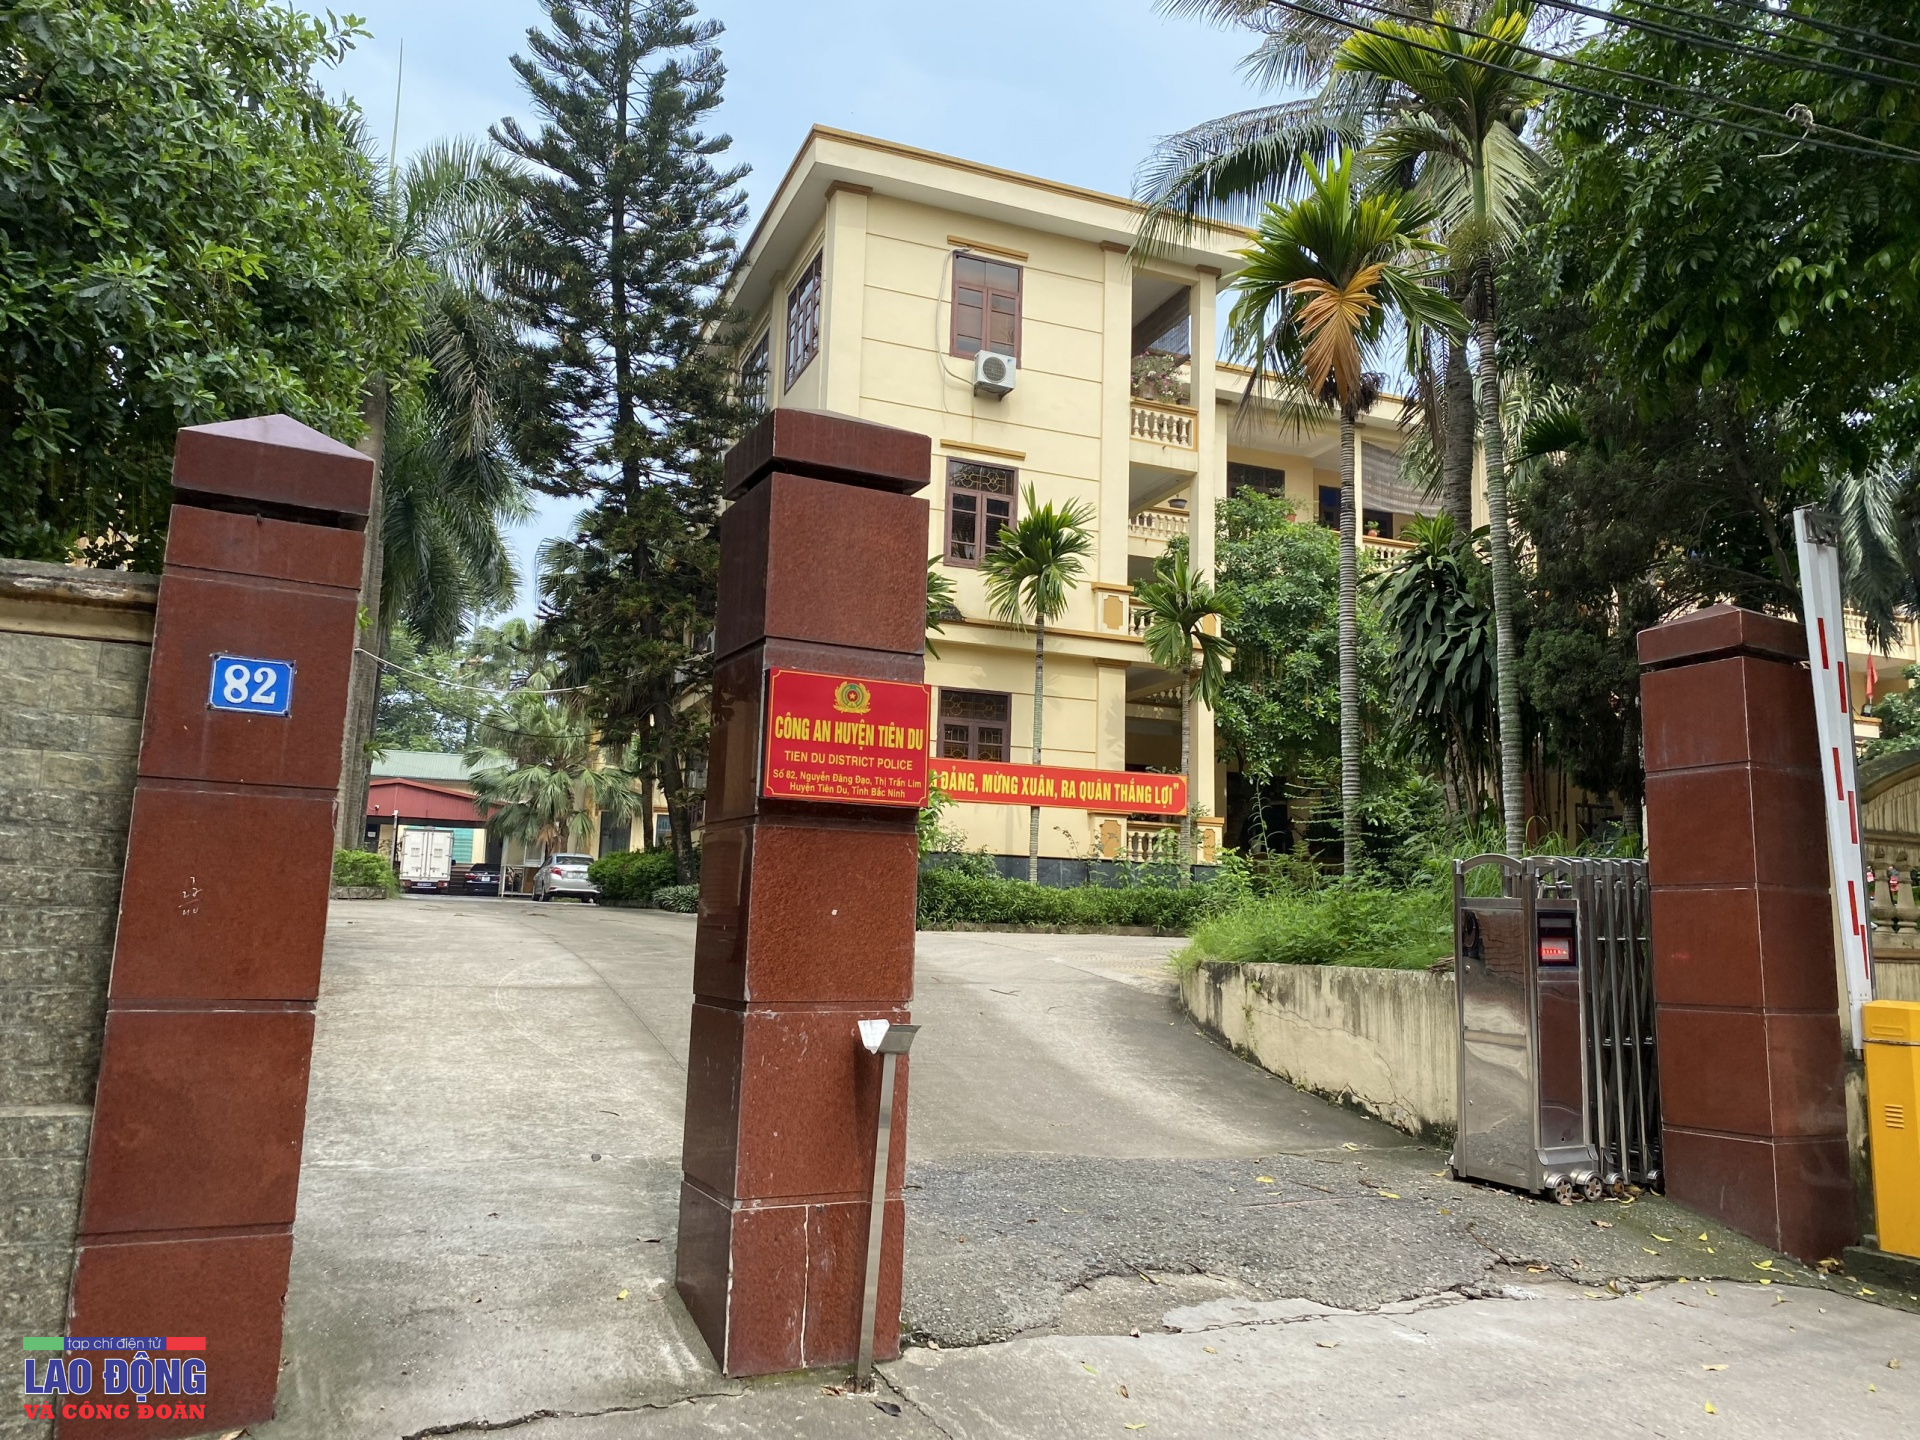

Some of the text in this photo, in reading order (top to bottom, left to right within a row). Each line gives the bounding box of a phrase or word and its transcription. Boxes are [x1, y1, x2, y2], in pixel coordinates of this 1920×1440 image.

[223, 664, 277, 704] 82
[775, 712, 924, 750] CÔNG AN HUYỆN TIÊN DU
[784, 750, 913, 771] TIEN DU DISTRICT POLICE
[773, 768, 785, 779] Số
[786, 770, 798, 781] 82,
[800, 770, 831, 783] Nguyễn
[832, 773, 853, 785] Đăng
[874, 776, 887, 788] Thị
[888, 777, 906, 788] Trấn
[907, 778, 922, 788] Lim
[789, 781, 815, 794] Huyện
[836, 785, 850, 796] Du,
[851, 785, 869, 796] Tỉnh
[871, 786, 886, 797] Bắc
[887, 788, 906, 798] Ninh
[940, 765, 979, 794] ĐẢNG,
[982, 771, 1018, 795] MỪNG
[1021, 774, 1058, 800] XUÂN,
[1061, 779, 1076, 799] RA
[1079, 778, 1112, 802] QUÂN
[1114, 778, 1152, 804] THẮNG
